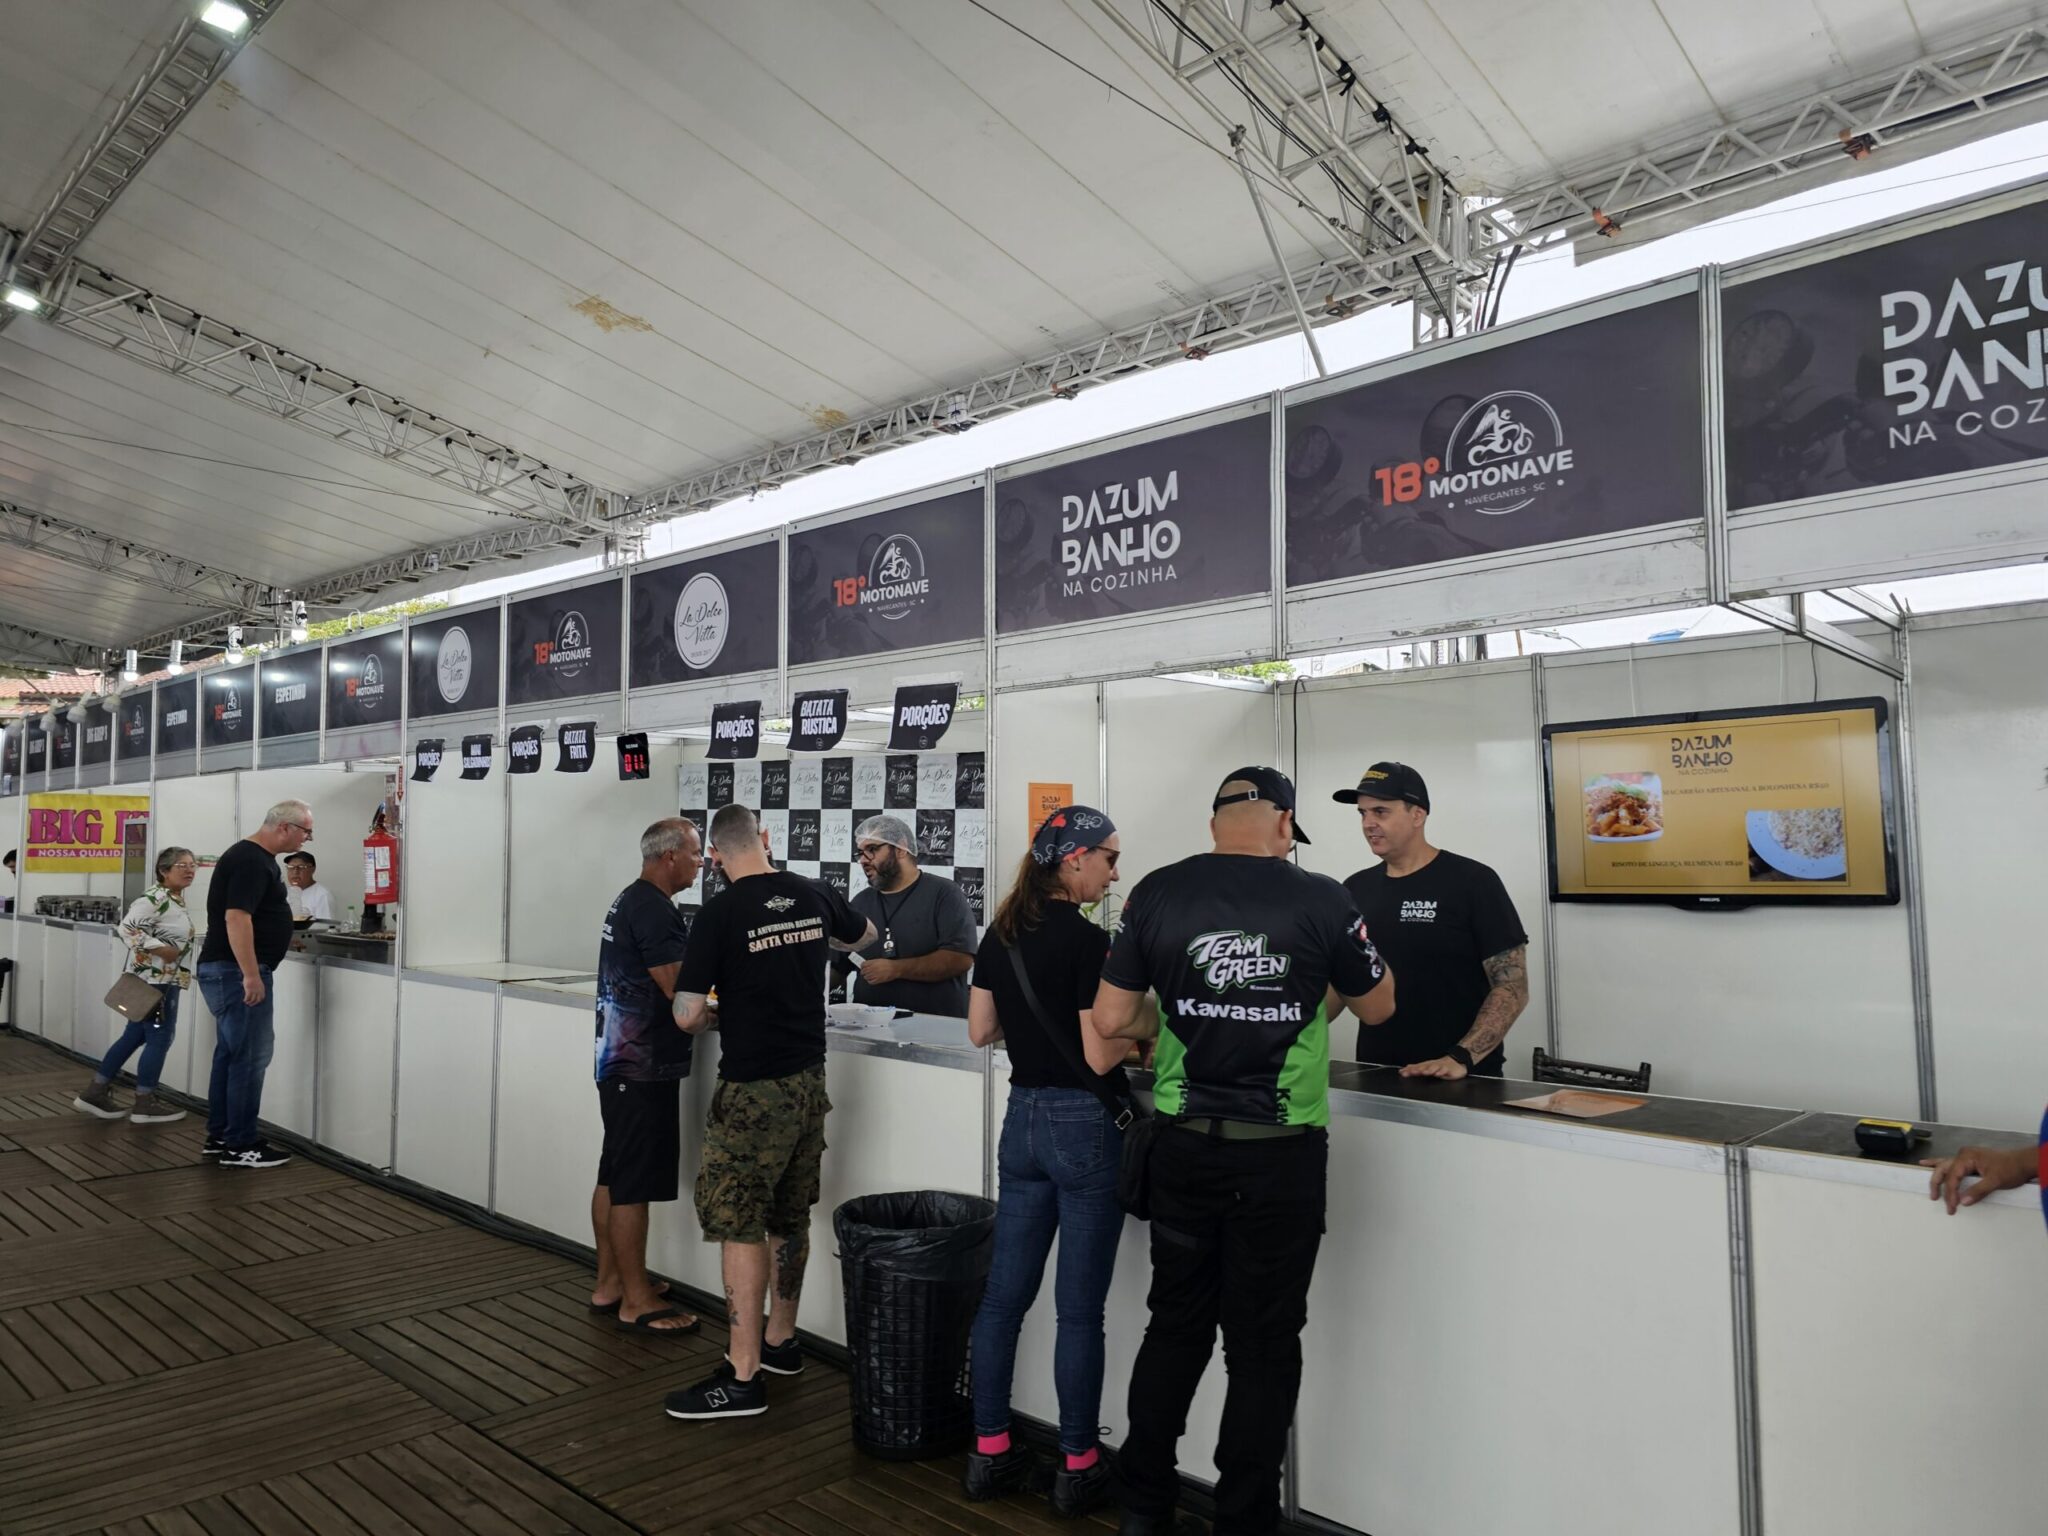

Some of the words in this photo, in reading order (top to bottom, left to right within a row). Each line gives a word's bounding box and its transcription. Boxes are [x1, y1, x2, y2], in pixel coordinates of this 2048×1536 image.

[1883, 328, 2048, 416] BAN
[1889, 421, 1937, 449] NA
[1429, 450, 1574, 498] MOTONAVE
[1062, 470, 1178, 533] DAZUM
[1465, 486, 1527, 506] NAVEGANTES
[1533, 482, 1546, 492] SC
[1062, 520, 1181, 577] BANHO
[860, 579, 929, 605] MOTONAVE
[1063, 581, 1083, 597] NA
[1090, 564, 1177, 593] COZINHA
[695, 601, 722, 623] Dolce
[550, 647, 591, 664] MOTONAVE
[275, 683, 306, 704] ESPETINHO
[356, 684, 384, 696] MOTONAVE
[801, 698, 834, 716] BATATA
[899, 700, 950, 730] PORÇÕES
[564, 730, 587, 745] BATATA
[715, 715, 755, 741] PORÇÕES
[801, 716, 837, 735] RUSTICA
[512, 737, 539, 759] PORÇÕES
[570, 744, 588, 759] FRITA
[1671, 734, 1732, 751] DAZUM
[1672, 751, 1733, 768] BANHO
[28, 809, 104, 845] BIG
[38, 849, 77, 858] NOSSA
[748, 935, 782, 953] SANTA
[783, 927, 824, 945] CATARINA
[1188, 931, 1264, 965] TEAM
[1207, 956, 1287, 989] GREEN
[1176, 998, 1302, 1022] Kawasaki
